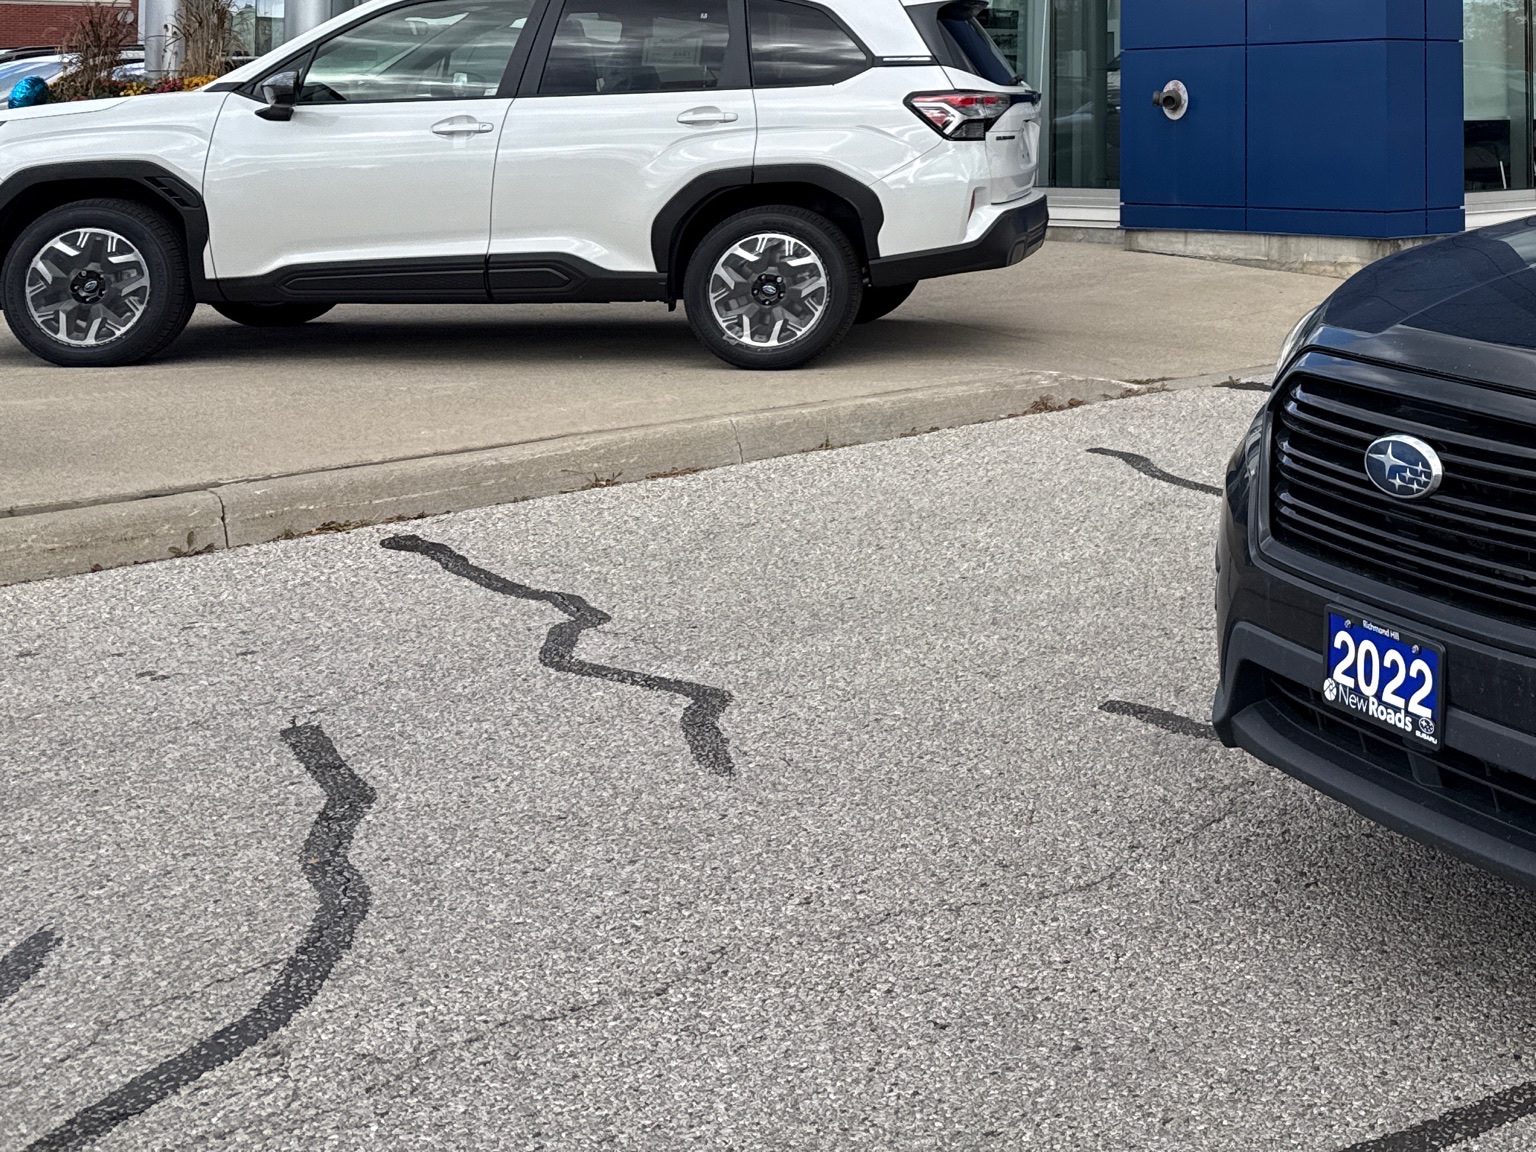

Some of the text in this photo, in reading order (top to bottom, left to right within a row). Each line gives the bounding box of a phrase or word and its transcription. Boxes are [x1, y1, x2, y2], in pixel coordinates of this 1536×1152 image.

[1362, 619, 1400, 642] Richmond Hill
[1332, 630, 1433, 718] 2022
[1338, 684, 1413, 732] NewRoads
